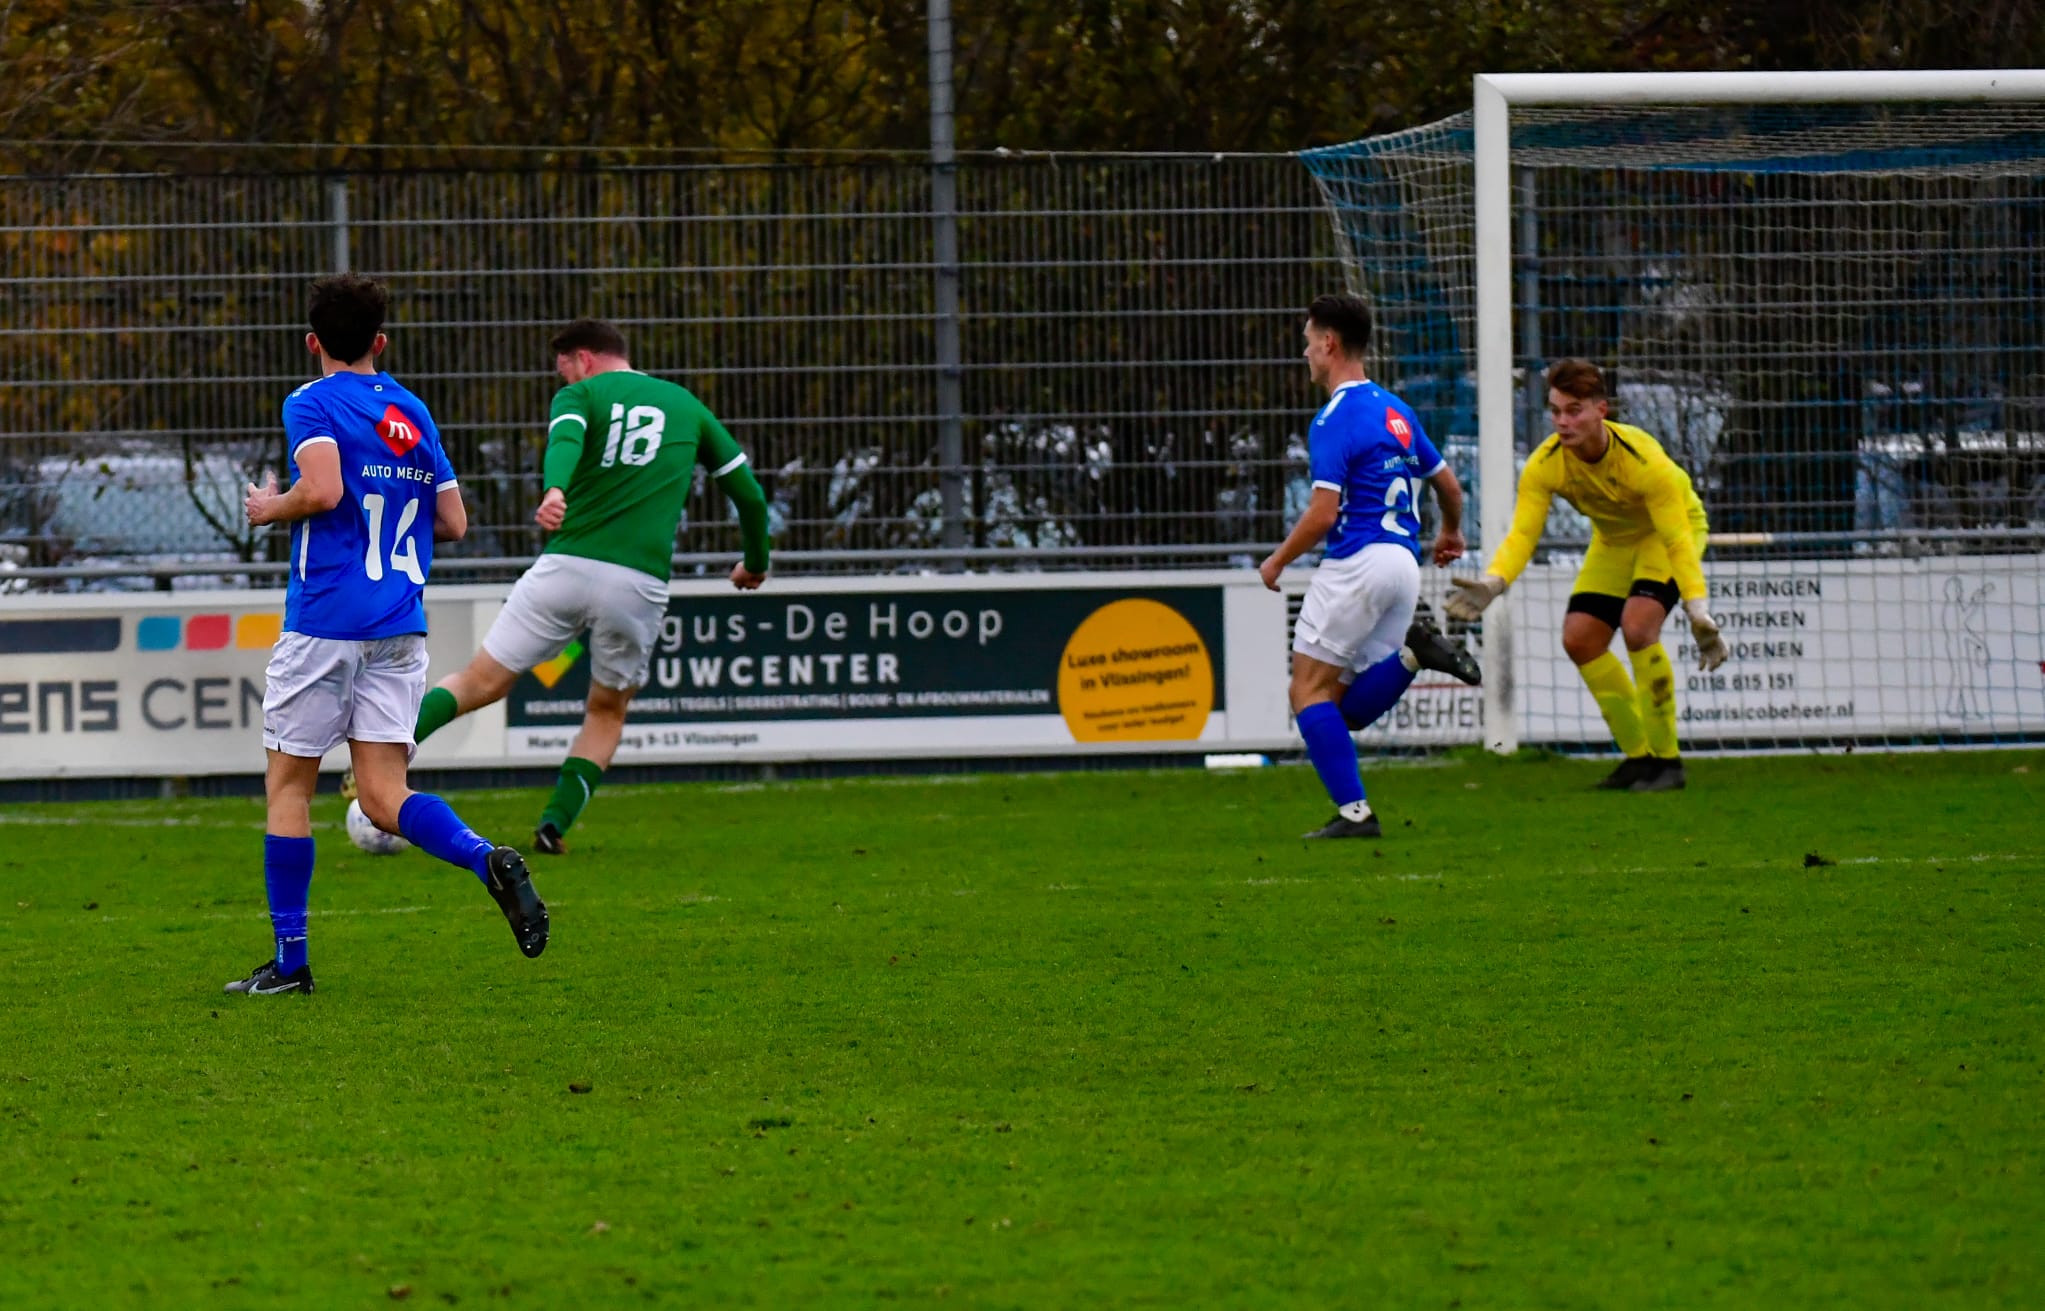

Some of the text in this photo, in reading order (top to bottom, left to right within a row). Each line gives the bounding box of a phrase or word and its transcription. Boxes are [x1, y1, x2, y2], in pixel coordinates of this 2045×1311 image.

[600, 403, 666, 468] 18
[362, 465, 392, 478] AUTO
[363, 493, 426, 585] 14
[1710, 580, 1821, 598] EKERINGEN
[869, 602, 1003, 645] Hoop
[1674, 611, 1806, 629] HOTHEKEN
[1068, 643, 1198, 669] Luxe showroom
[1678, 641, 1803, 659] PEIOENEN
[656, 654, 900, 688] UWCENTER
[1688, 675, 1726, 691] 0118
[1769, 673, 1794, 689] 151
[1080, 676, 1096, 690] in
[141, 678, 264, 731] CEN
